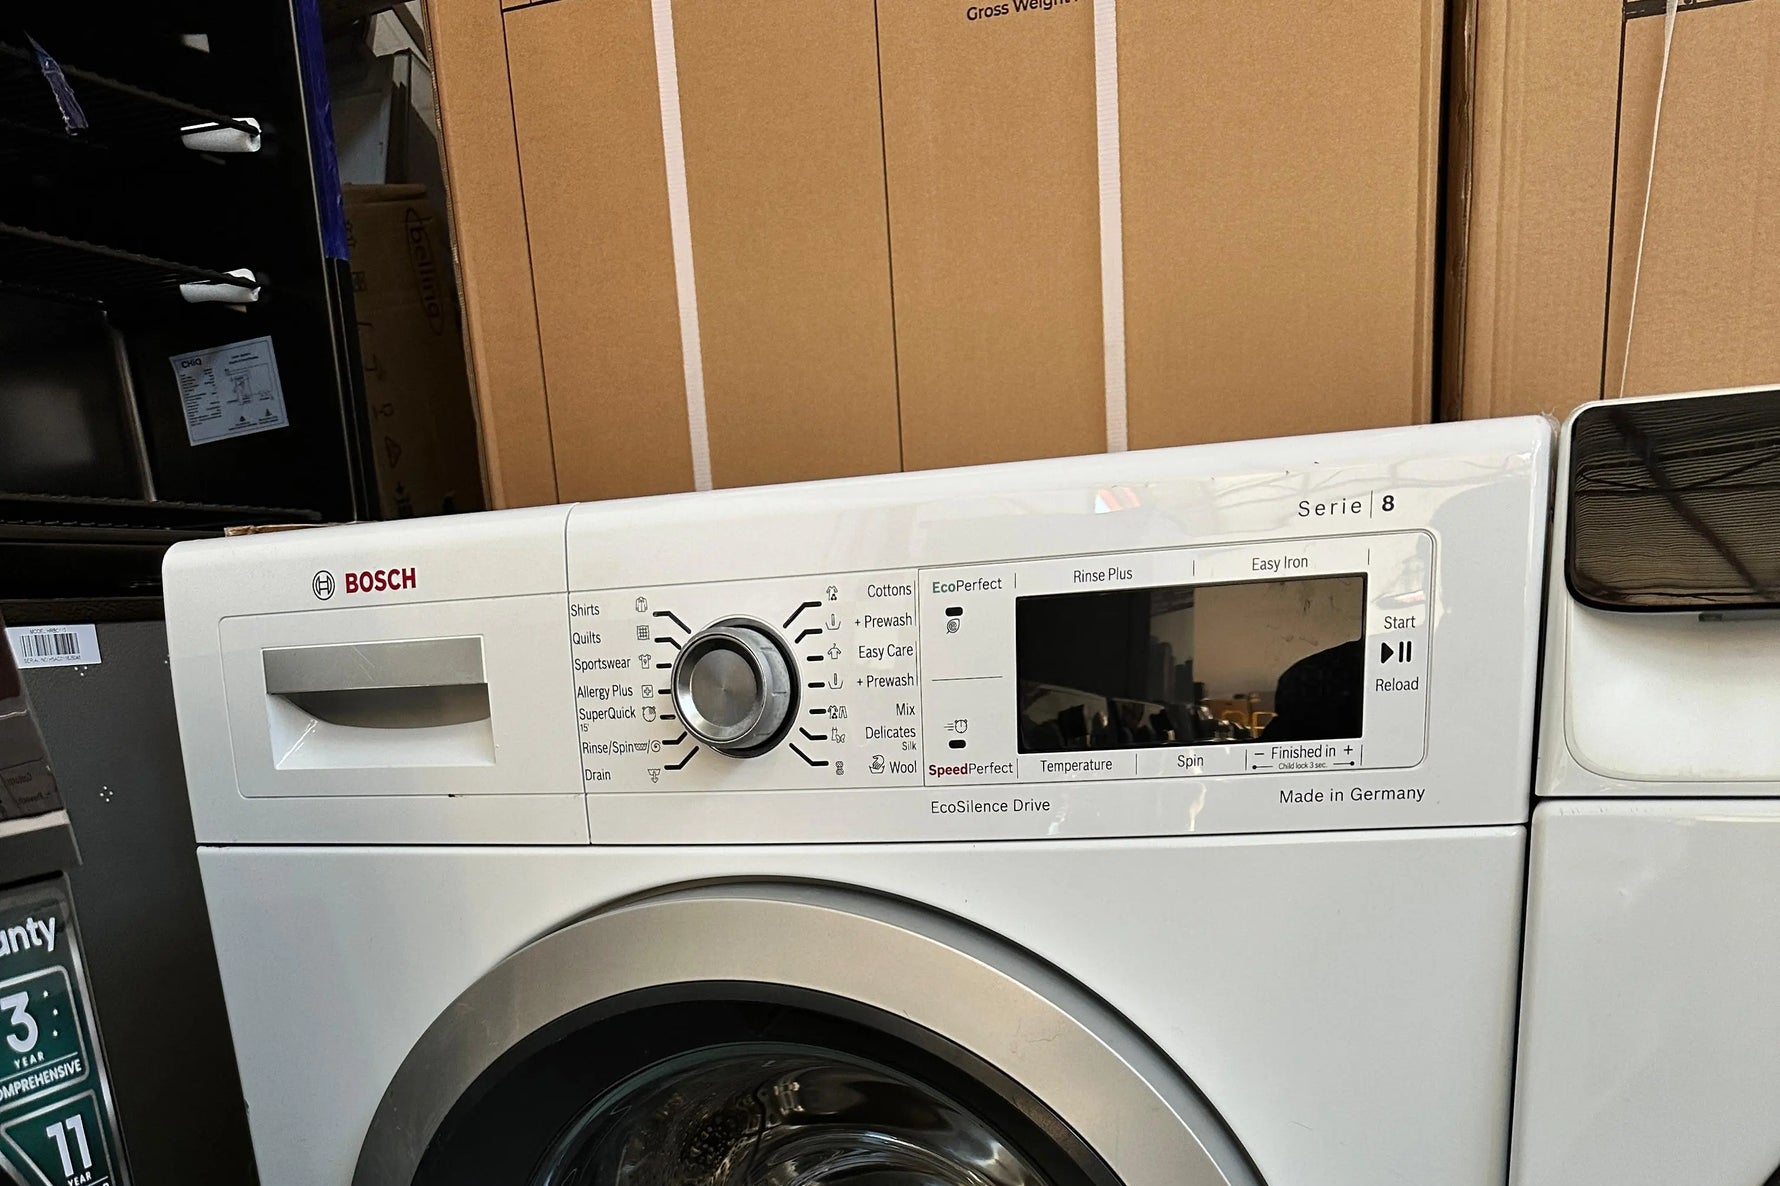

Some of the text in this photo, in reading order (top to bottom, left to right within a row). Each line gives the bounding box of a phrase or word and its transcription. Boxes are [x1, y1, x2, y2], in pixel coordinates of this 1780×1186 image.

[967, 0, 1071, 21] Gross Weig
[1298, 494, 1395, 518] Serie 8
[1252, 555, 1309, 573] Easy Iron
[345, 567, 417, 594] BOSCH
[1073, 567, 1133, 584] Rinse Plus
[867, 584, 912, 598] Cottons
[932, 577, 1003, 594] EcoPerfect
[570, 603, 600, 617] Shirts
[864, 612, 913, 629] Prewash
[1383, 615, 1416, 630] Start
[572, 630, 602, 645] Quilts
[858, 643, 914, 661] Easy Care
[574, 658, 631, 674] Sportswear
[866, 672, 915, 689] Prewash
[1375, 676, 1419, 692] Reload
[577, 683, 634, 701] Allergy Plus
[578, 706, 637, 722] SuperQuick
[895, 703, 916, 716] Mix
[865, 725, 917, 740] Delicates
[582, 740, 635, 756] Rinse/Spin
[901, 741, 917, 751] Silk
[1271, 744, 1323, 760] Finished
[1325, 744, 1336, 758] in
[889, 760, 917, 774] Wool
[928, 762, 1014, 778] SpeedPerfect
[1040, 758, 1114, 774] Temperature
[1176, 754, 1205, 770] Spin
[1278, 762, 1294, 770] Child
[1295, 761, 1309, 769] lock
[584, 768, 612, 781] Drain
[1279, 787, 1426, 804] Made in Germany
[931, 798, 1051, 814] EcoSilence Drive
[0, 991, 39, 1052] 3
[14, 1051, 45, 1069] YEAR
[46, 1114, 92, 1178] 11
